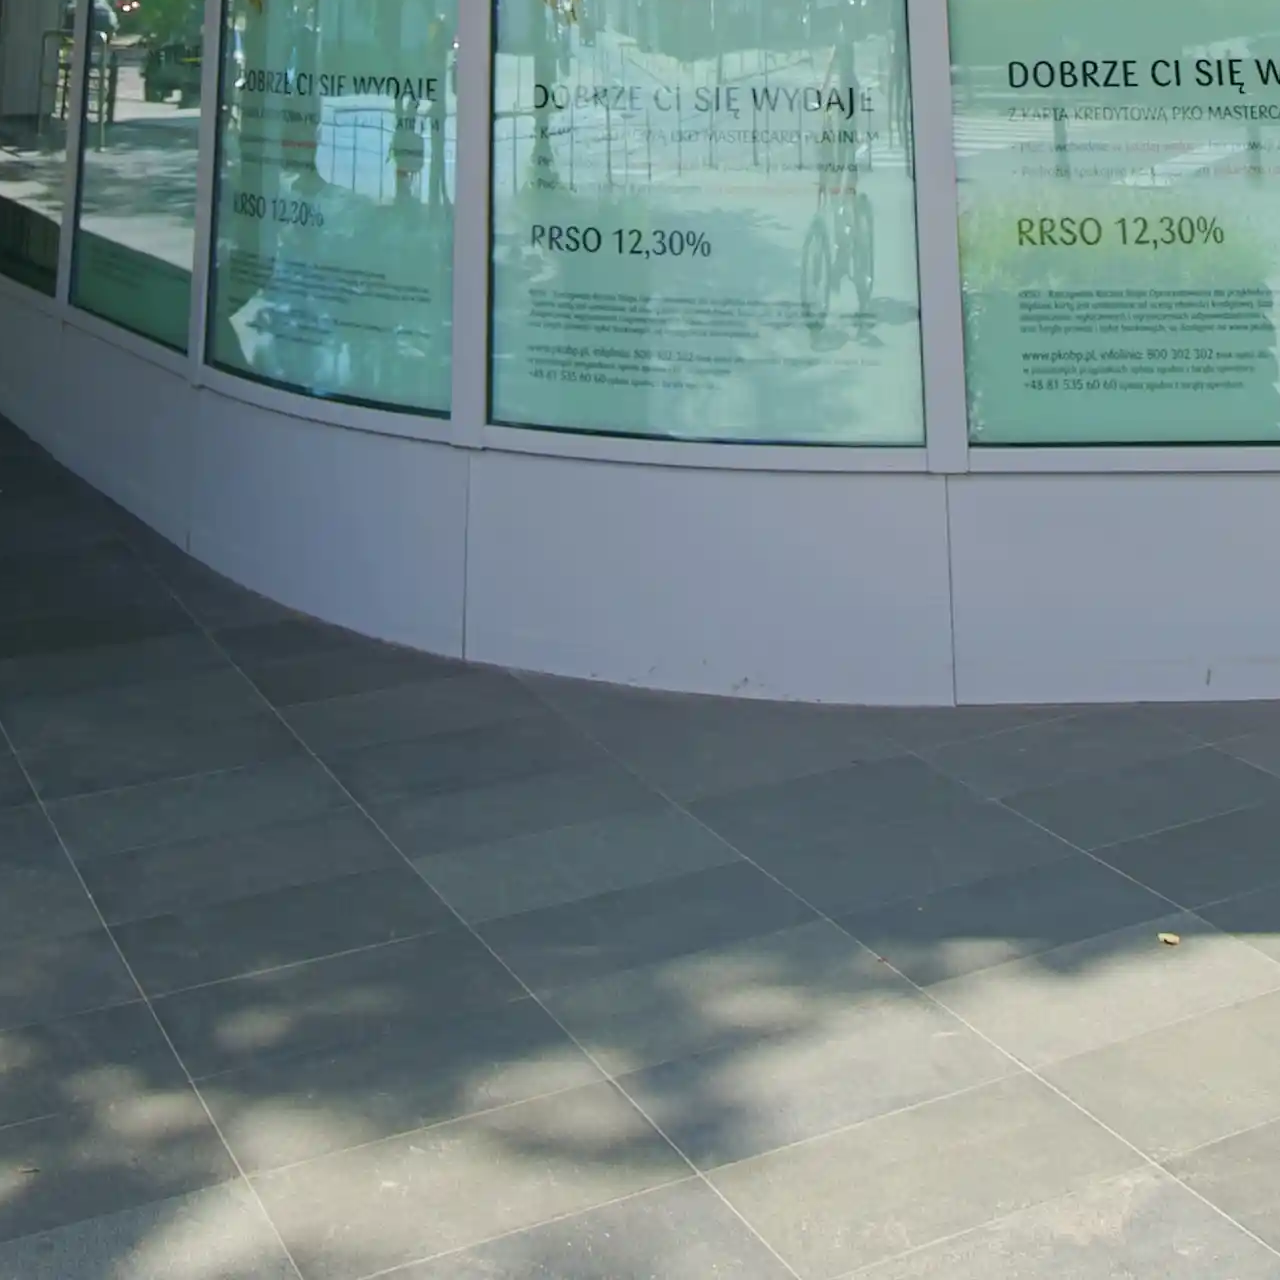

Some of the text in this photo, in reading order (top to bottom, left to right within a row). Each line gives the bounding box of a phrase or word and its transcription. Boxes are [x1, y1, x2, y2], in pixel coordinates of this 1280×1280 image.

[1007, 59, 1139, 88] DOBRZE
[1150, 58, 1182, 88] CI
[1195, 57, 1246, 94] SIĘ
[653, 87, 682, 112] CI
[694, 87, 741, 119] SIĘ
[752, 87, 876, 120] WYDAJE
[1172, 105, 1203, 121] PKO
[530, 224, 712, 260] RRSO 12,30%
[1016, 215, 1225, 250] RRSO 12,30%
[1195, 348, 1214, 360] 302
